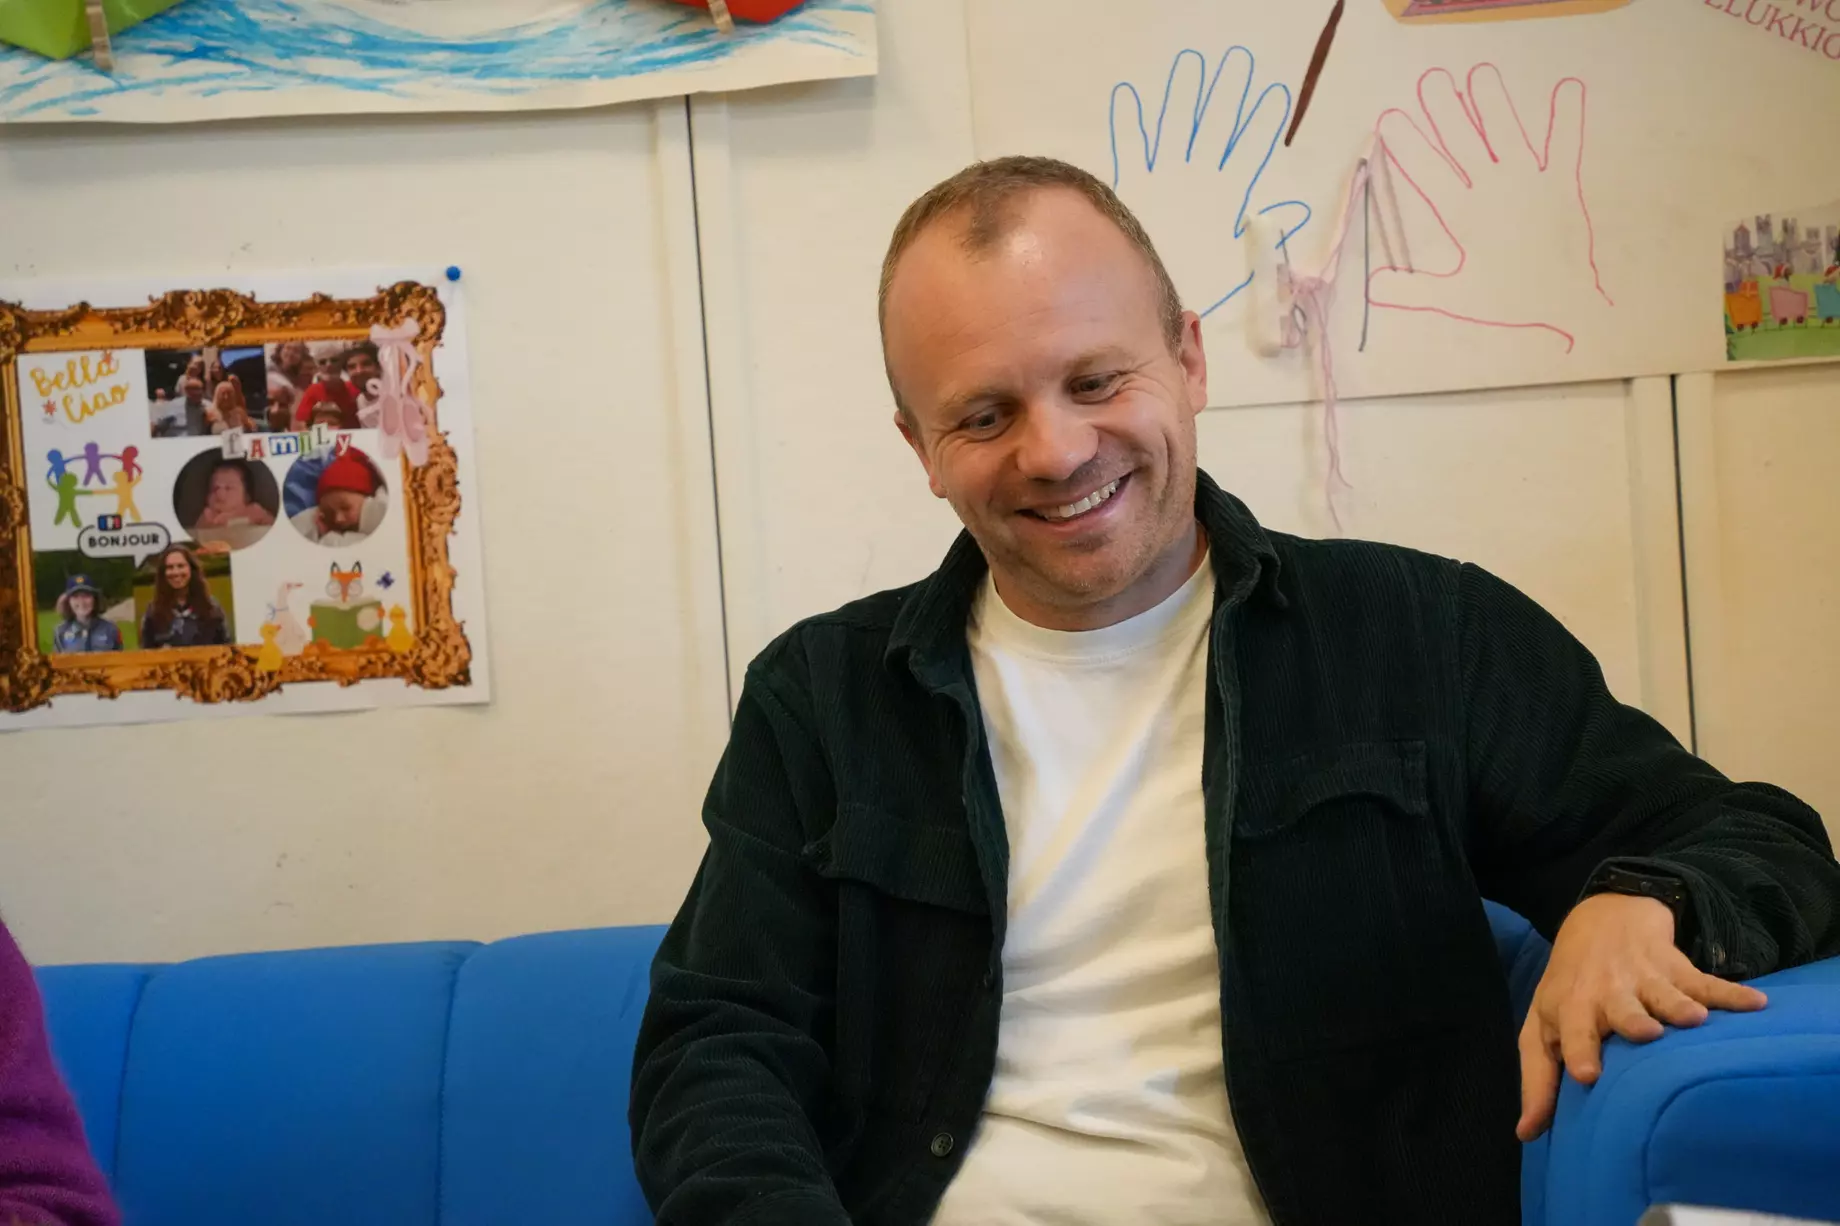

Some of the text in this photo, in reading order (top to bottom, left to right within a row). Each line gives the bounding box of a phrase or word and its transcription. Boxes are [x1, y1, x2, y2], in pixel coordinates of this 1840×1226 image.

[30, 355, 119, 397] Bella
[62, 382, 129, 424] Ciao
[88, 533, 159, 548] BONJOUR
